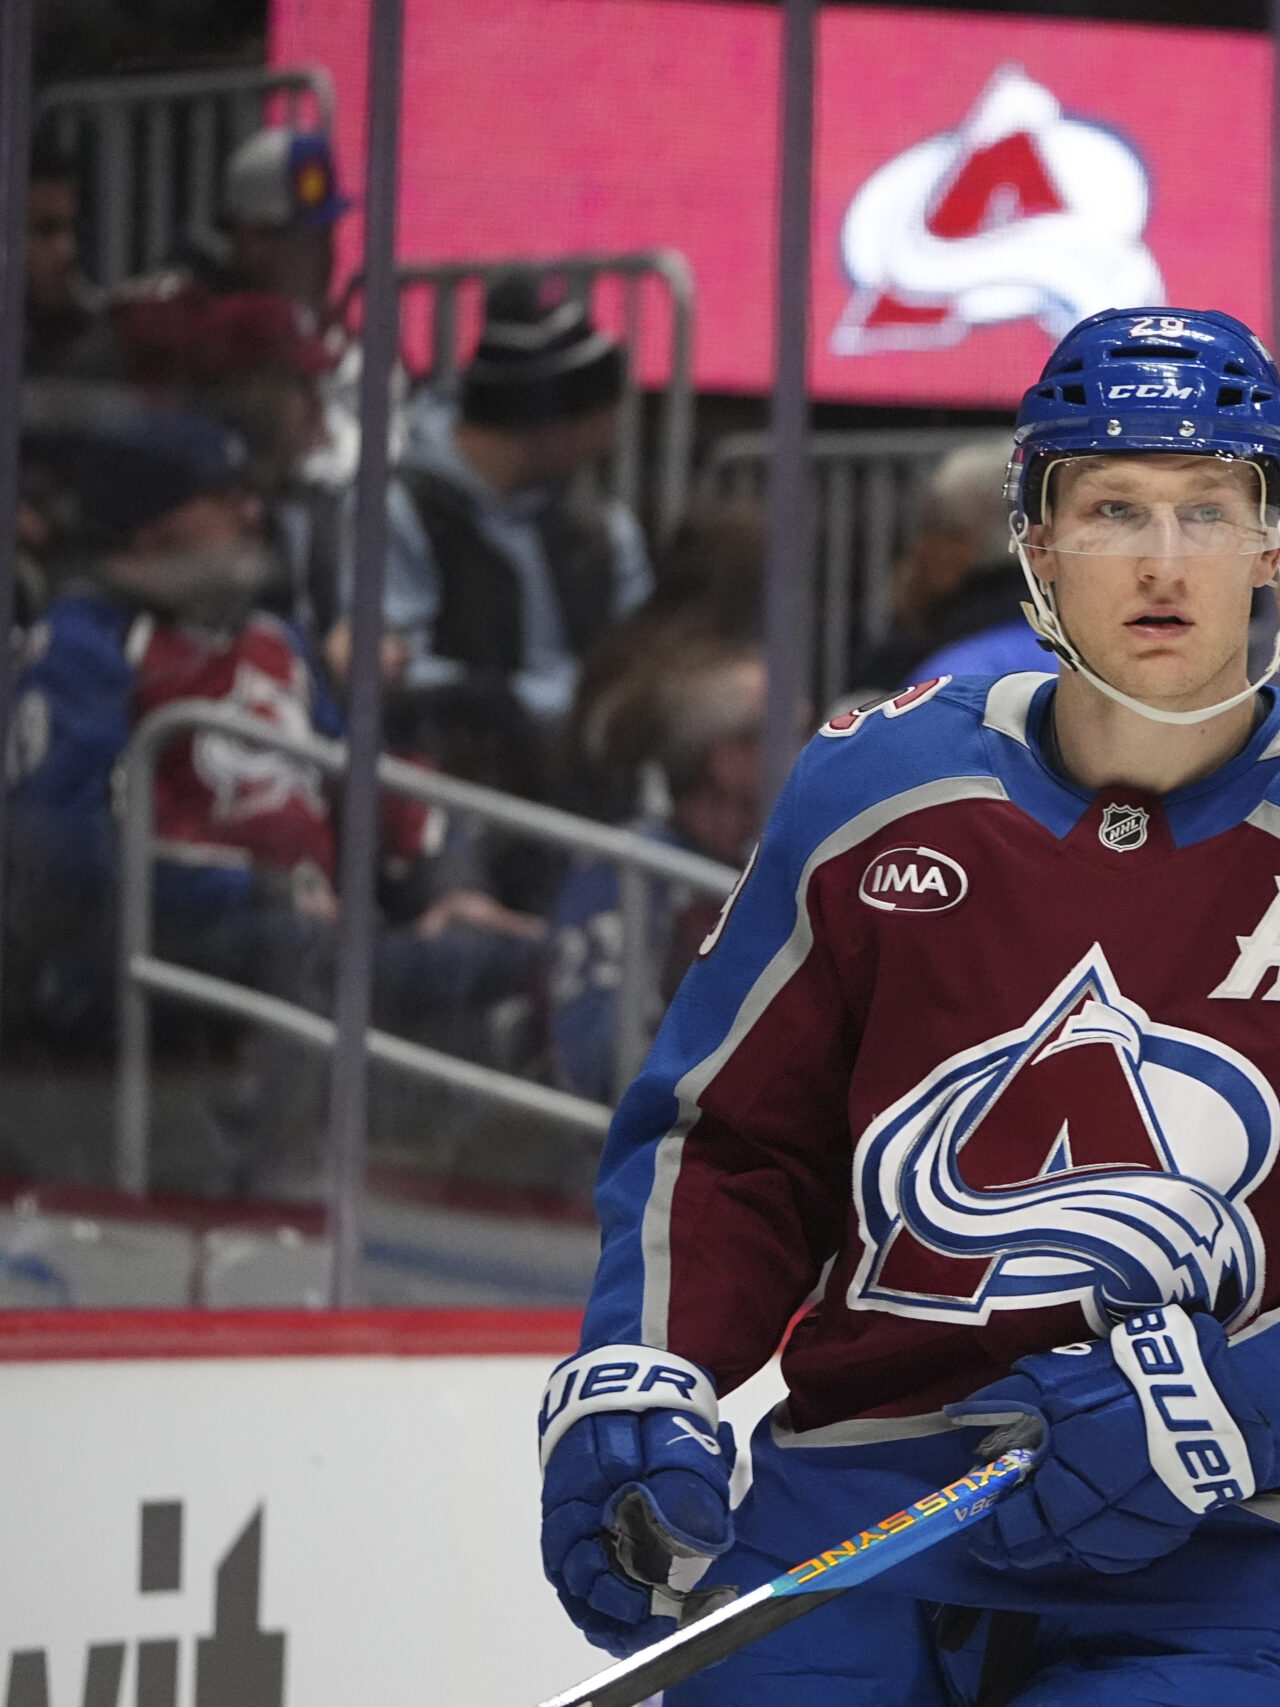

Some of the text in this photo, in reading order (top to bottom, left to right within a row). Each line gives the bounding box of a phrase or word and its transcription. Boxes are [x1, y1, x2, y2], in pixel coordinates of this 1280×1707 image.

[1129, 316, 1187, 340] 29
[1107, 383, 1194, 400] CCM
[1109, 818, 1139, 841] NHL
[871, 863, 949, 897] IMA
[787, 1509, 916, 1584] SYNC
